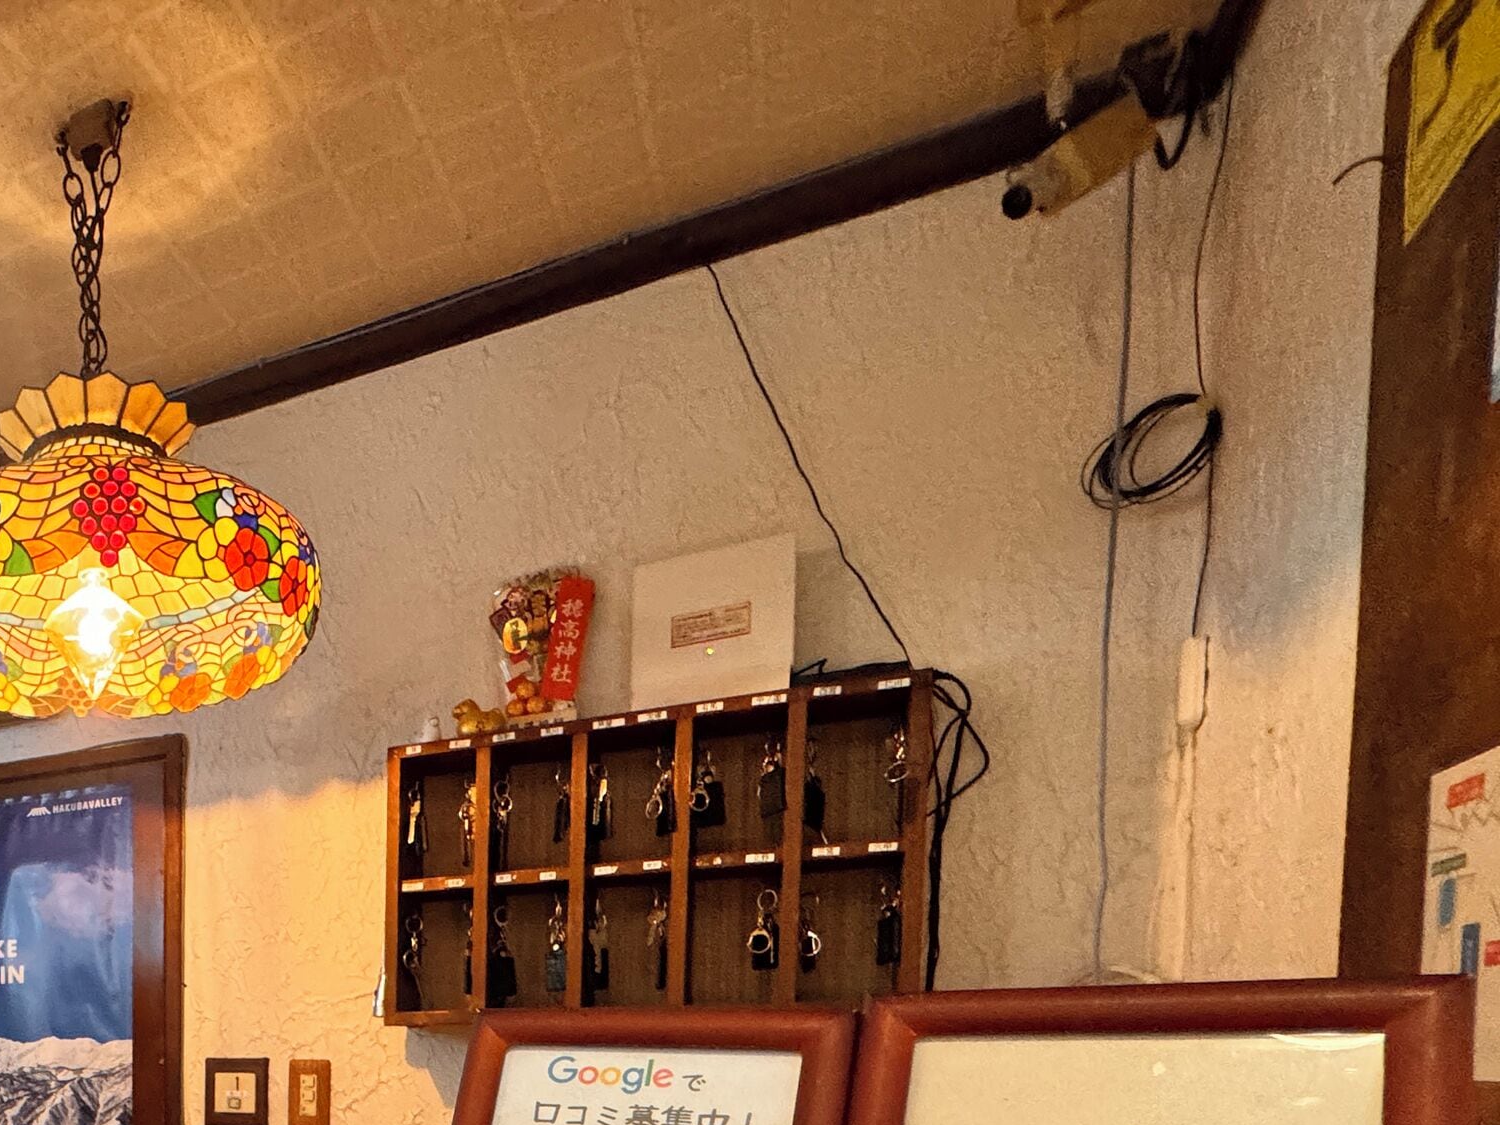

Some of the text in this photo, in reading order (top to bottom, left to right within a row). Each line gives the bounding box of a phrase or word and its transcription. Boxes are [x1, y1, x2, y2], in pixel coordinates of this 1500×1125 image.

[551, 599, 584, 683] 穂高神社
[52, 796, 123, 814] HAKUBAVALLEY
[548, 1055, 707, 1095] Google で
